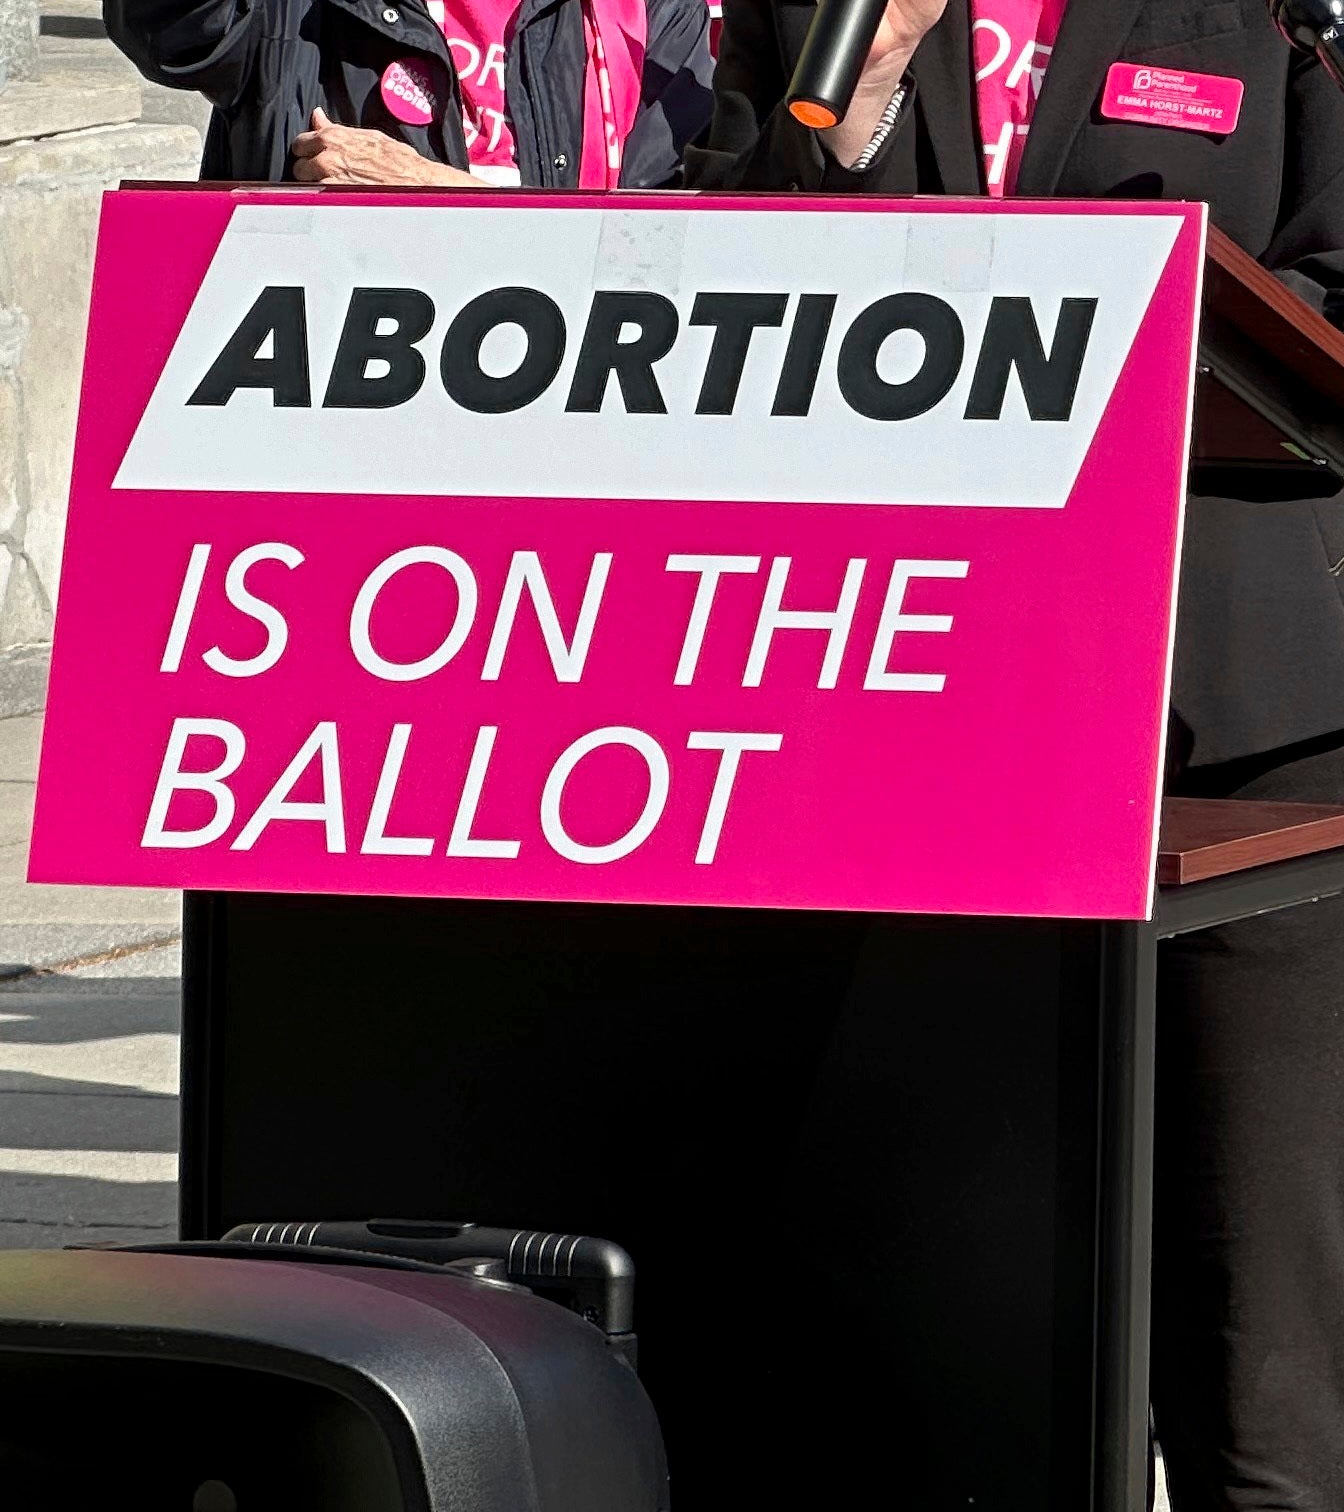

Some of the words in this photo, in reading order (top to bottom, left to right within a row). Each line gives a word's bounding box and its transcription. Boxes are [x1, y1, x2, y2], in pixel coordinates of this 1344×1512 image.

[186, 286, 1099, 422] ABORTION
[160, 542, 305, 678] IS
[348, 546, 614, 684] ON
[662, 555, 970, 694] THE
[139, 717, 784, 867] BALLOT
